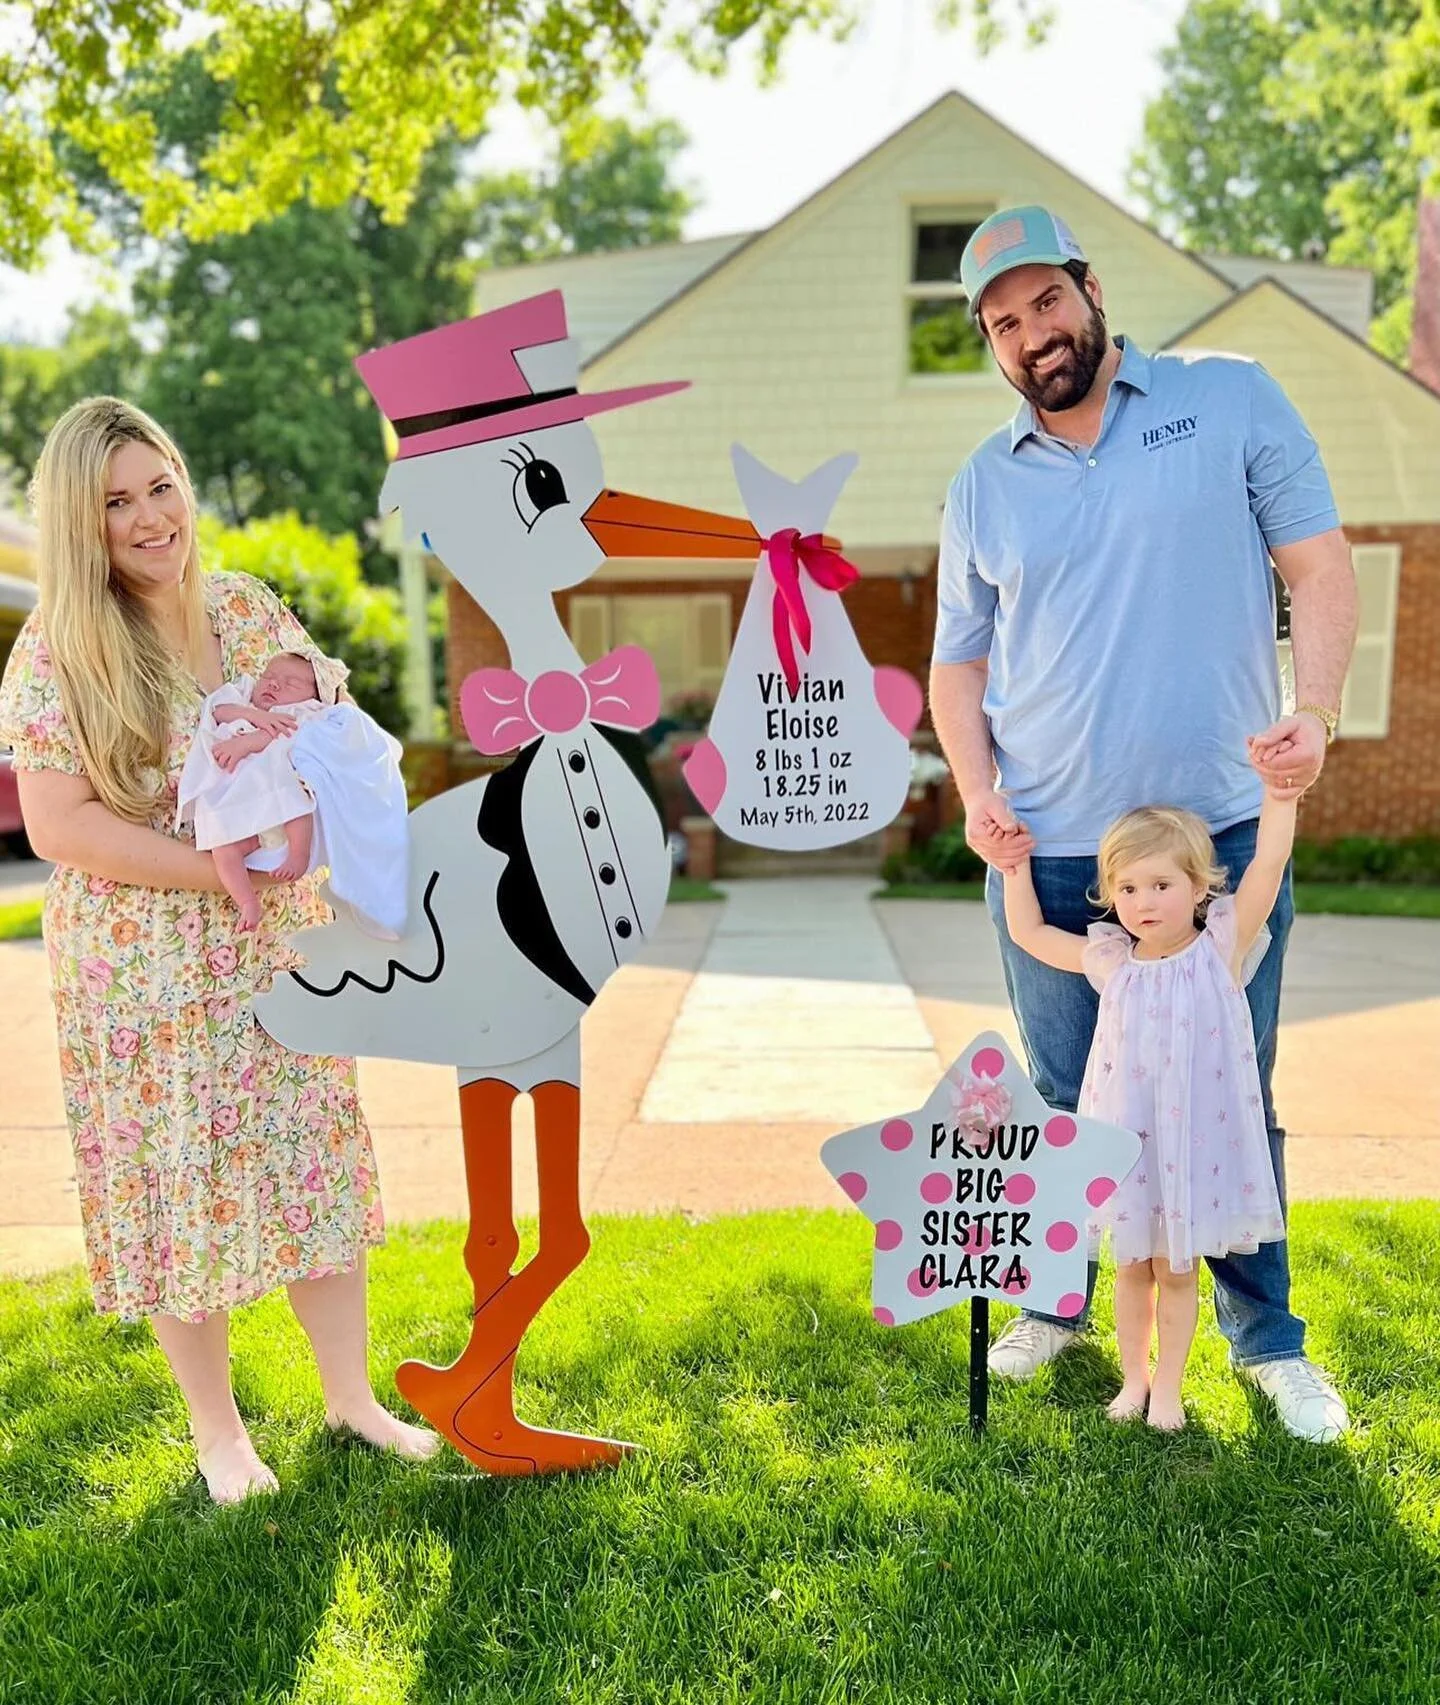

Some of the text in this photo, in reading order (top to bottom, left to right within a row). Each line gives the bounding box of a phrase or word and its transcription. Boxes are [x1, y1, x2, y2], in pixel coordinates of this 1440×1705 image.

[1142, 416, 1198, 447] HENRY
[757, 672, 844, 704] Vivian
[766, 708, 839, 741] Eloise
[755, 746, 852, 772] 8 lbs 1 oz
[763, 774, 847, 798] 18.25 in
[740, 802, 869, 828] May 5th, 2022
[956, 1167, 1006, 1204] BIG
[920, 1210, 1032, 1247] SISTER
[918, 1253, 1027, 1289] CLARA
